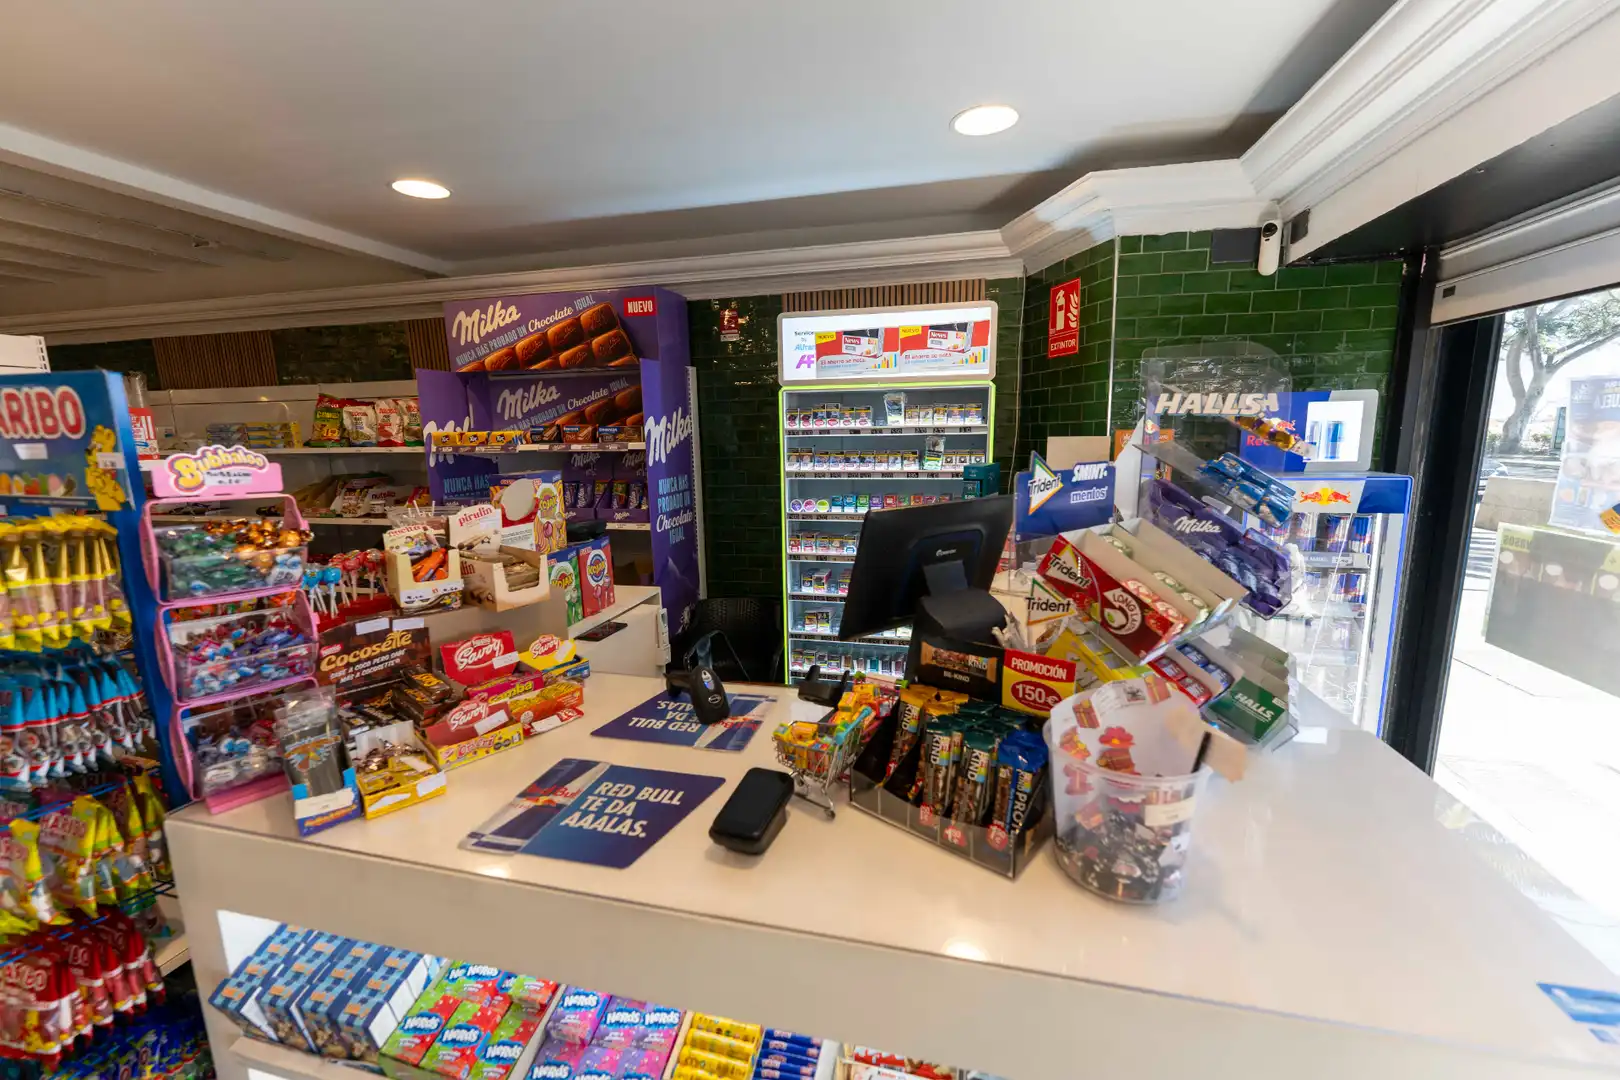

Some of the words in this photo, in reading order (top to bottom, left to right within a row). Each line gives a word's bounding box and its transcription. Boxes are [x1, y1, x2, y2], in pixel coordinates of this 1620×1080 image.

[627, 301, 654, 314] NUEVO
[452, 300, 521, 346] Milka
[456, 350, 477, 366] NUNCA
[477, 343, 490, 356] HAS
[489, 331, 518, 351] PROBADO
[517, 325, 528, 338] UN
[528, 306, 574, 332] Chocolate
[574, 294, 596, 312] IGUAL
[930, 331, 947, 339] News
[1051, 339, 1076, 351] EXTINTOR
[497, 381, 561, 420] Milka
[567, 388, 608, 410] Chocolate
[1154, 393, 1264, 415] HALLS
[645, 407, 692, 467] Milka
[443, 476, 473, 494] NUNCA
[473, 474, 490, 490] HAS
[658, 477, 678, 495] NUNCA
[678, 474, 689, 491] HAS
[1028, 474, 1062, 496] Trident
[1070, 486, 1108, 503] mentos
[657, 493, 684, 513] PROBADO
[458, 507, 493, 528] pirulin
[656, 509, 692, 532] Chocolate
[1173, 515, 1222, 534] Milka
[587, 559, 606, 575] KOJAK
[1050, 553, 1092, 589] Trident
[552, 573, 574, 589] KOJAK
[1025, 596, 1071, 612] Trident
[1112, 592, 1137, 612] LONG
[320, 631, 412, 671] Cocosette
[457, 637, 503, 671] Savoy
[532, 637, 560, 659] Savoy
[1011, 656, 1068, 681] PROMOCIÓN
[450, 702, 487, 731] Savoy
[665, 711, 689, 720] DA
[901, 703, 914, 730] KIND
[1235, 692, 1276, 722] HALLS
[628, 716, 666, 729] BULL
[668, 721, 701, 733] RED
[930, 733, 941, 765] KIND
[967, 749, 979, 781] KIND
[593, 781, 638, 800] RED
[636, 786, 685, 806] BULL
[579, 794, 606, 813] TE
[603, 799, 636, 817] DA
[560, 812, 647, 838] AAALAS.
